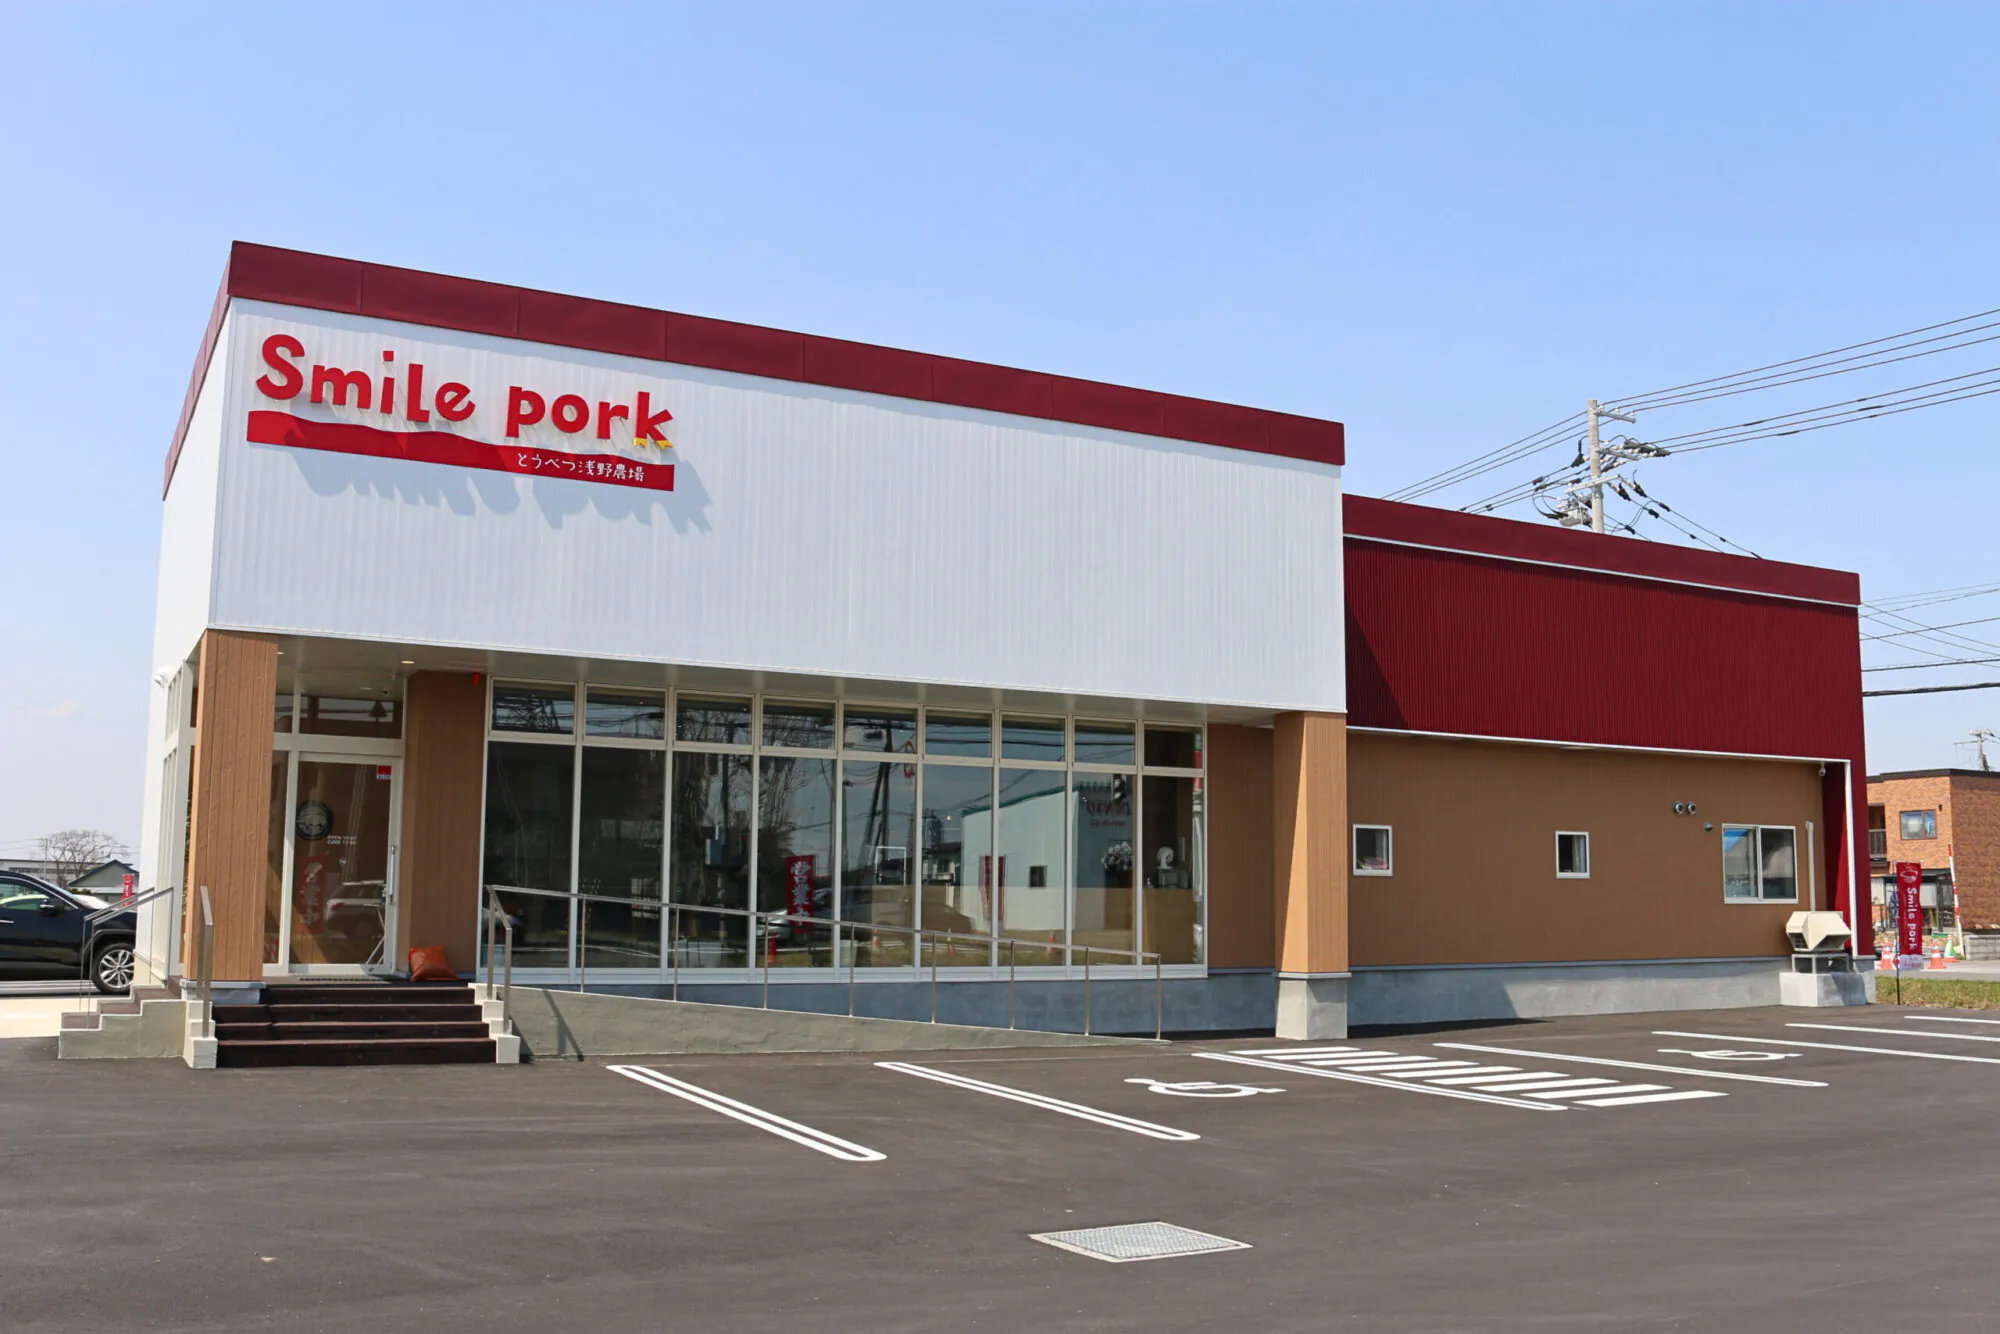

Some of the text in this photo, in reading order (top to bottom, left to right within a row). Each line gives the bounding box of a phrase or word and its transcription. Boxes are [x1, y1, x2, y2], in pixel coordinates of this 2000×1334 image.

[505, 385, 674, 451] pork
[517, 452, 645, 482] とうべつ浅野農場
